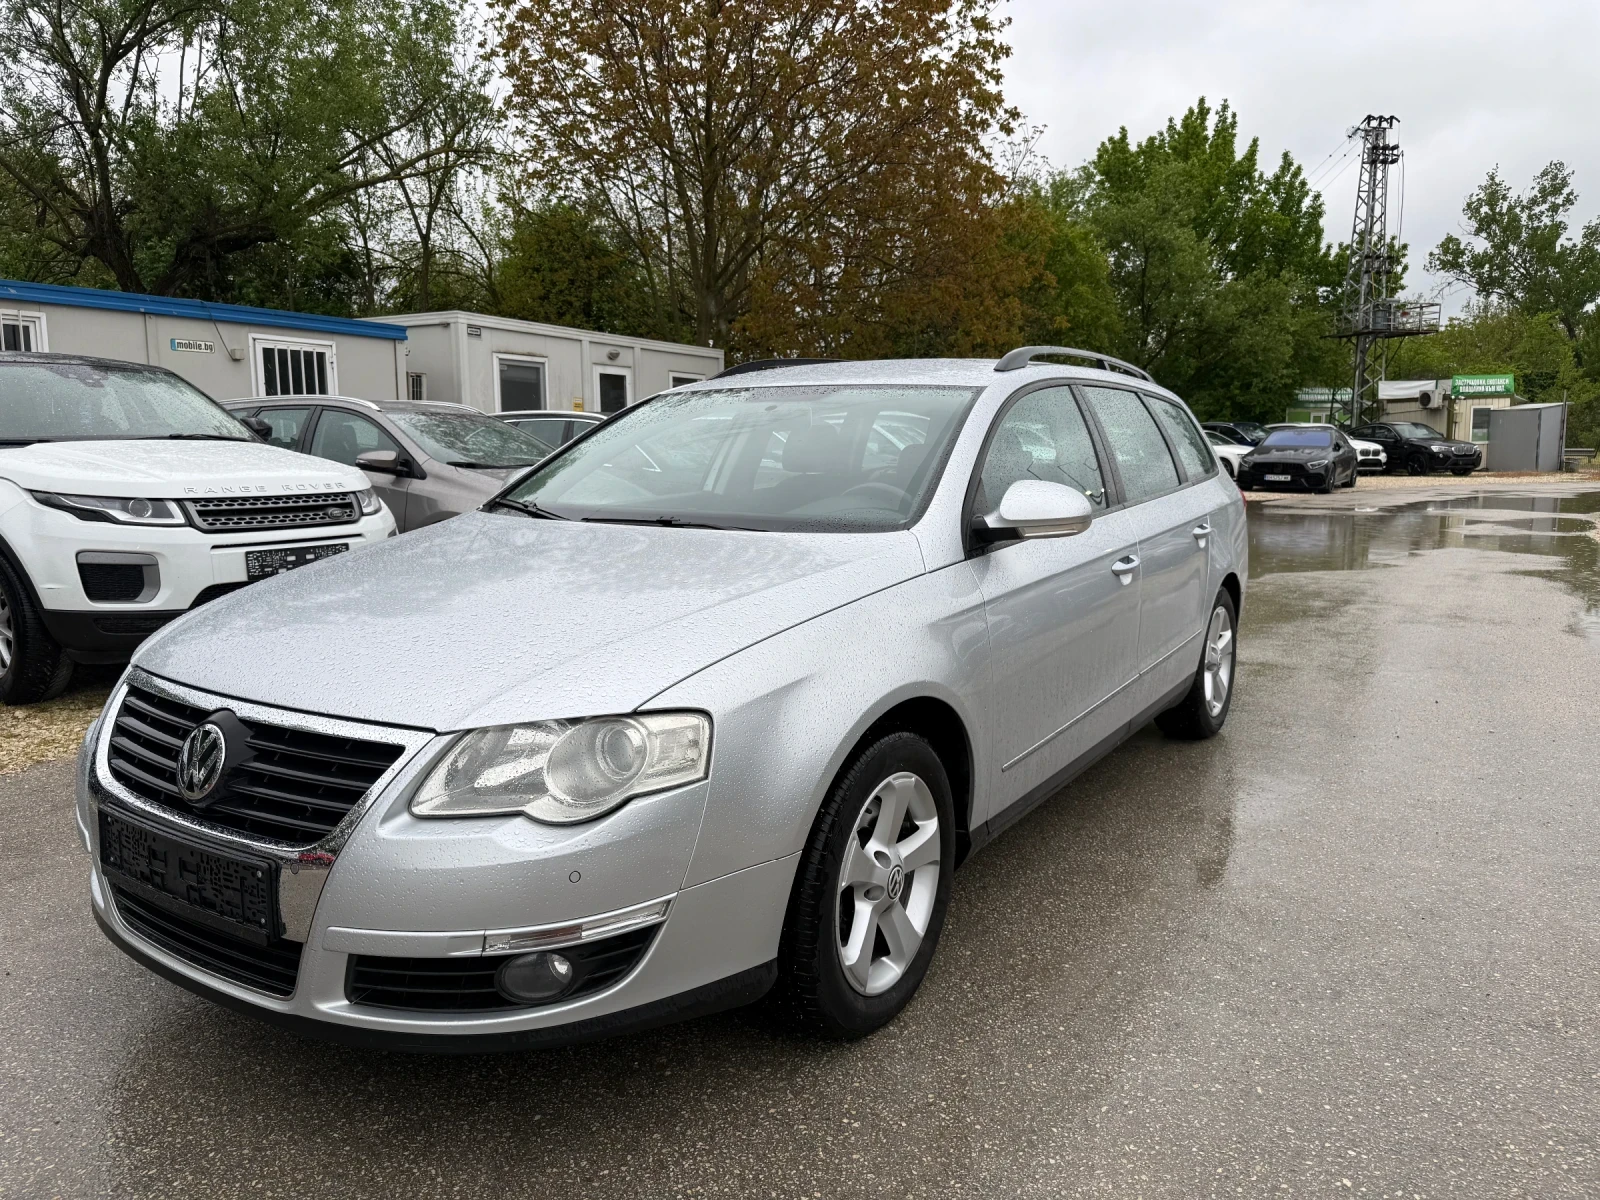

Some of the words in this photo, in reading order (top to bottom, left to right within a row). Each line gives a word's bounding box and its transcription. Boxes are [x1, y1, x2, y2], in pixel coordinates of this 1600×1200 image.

[176, 341, 213, 353] mobile.bg
[183, 485, 267, 494] RANGE
[281, 482, 346, 491] ROVER
